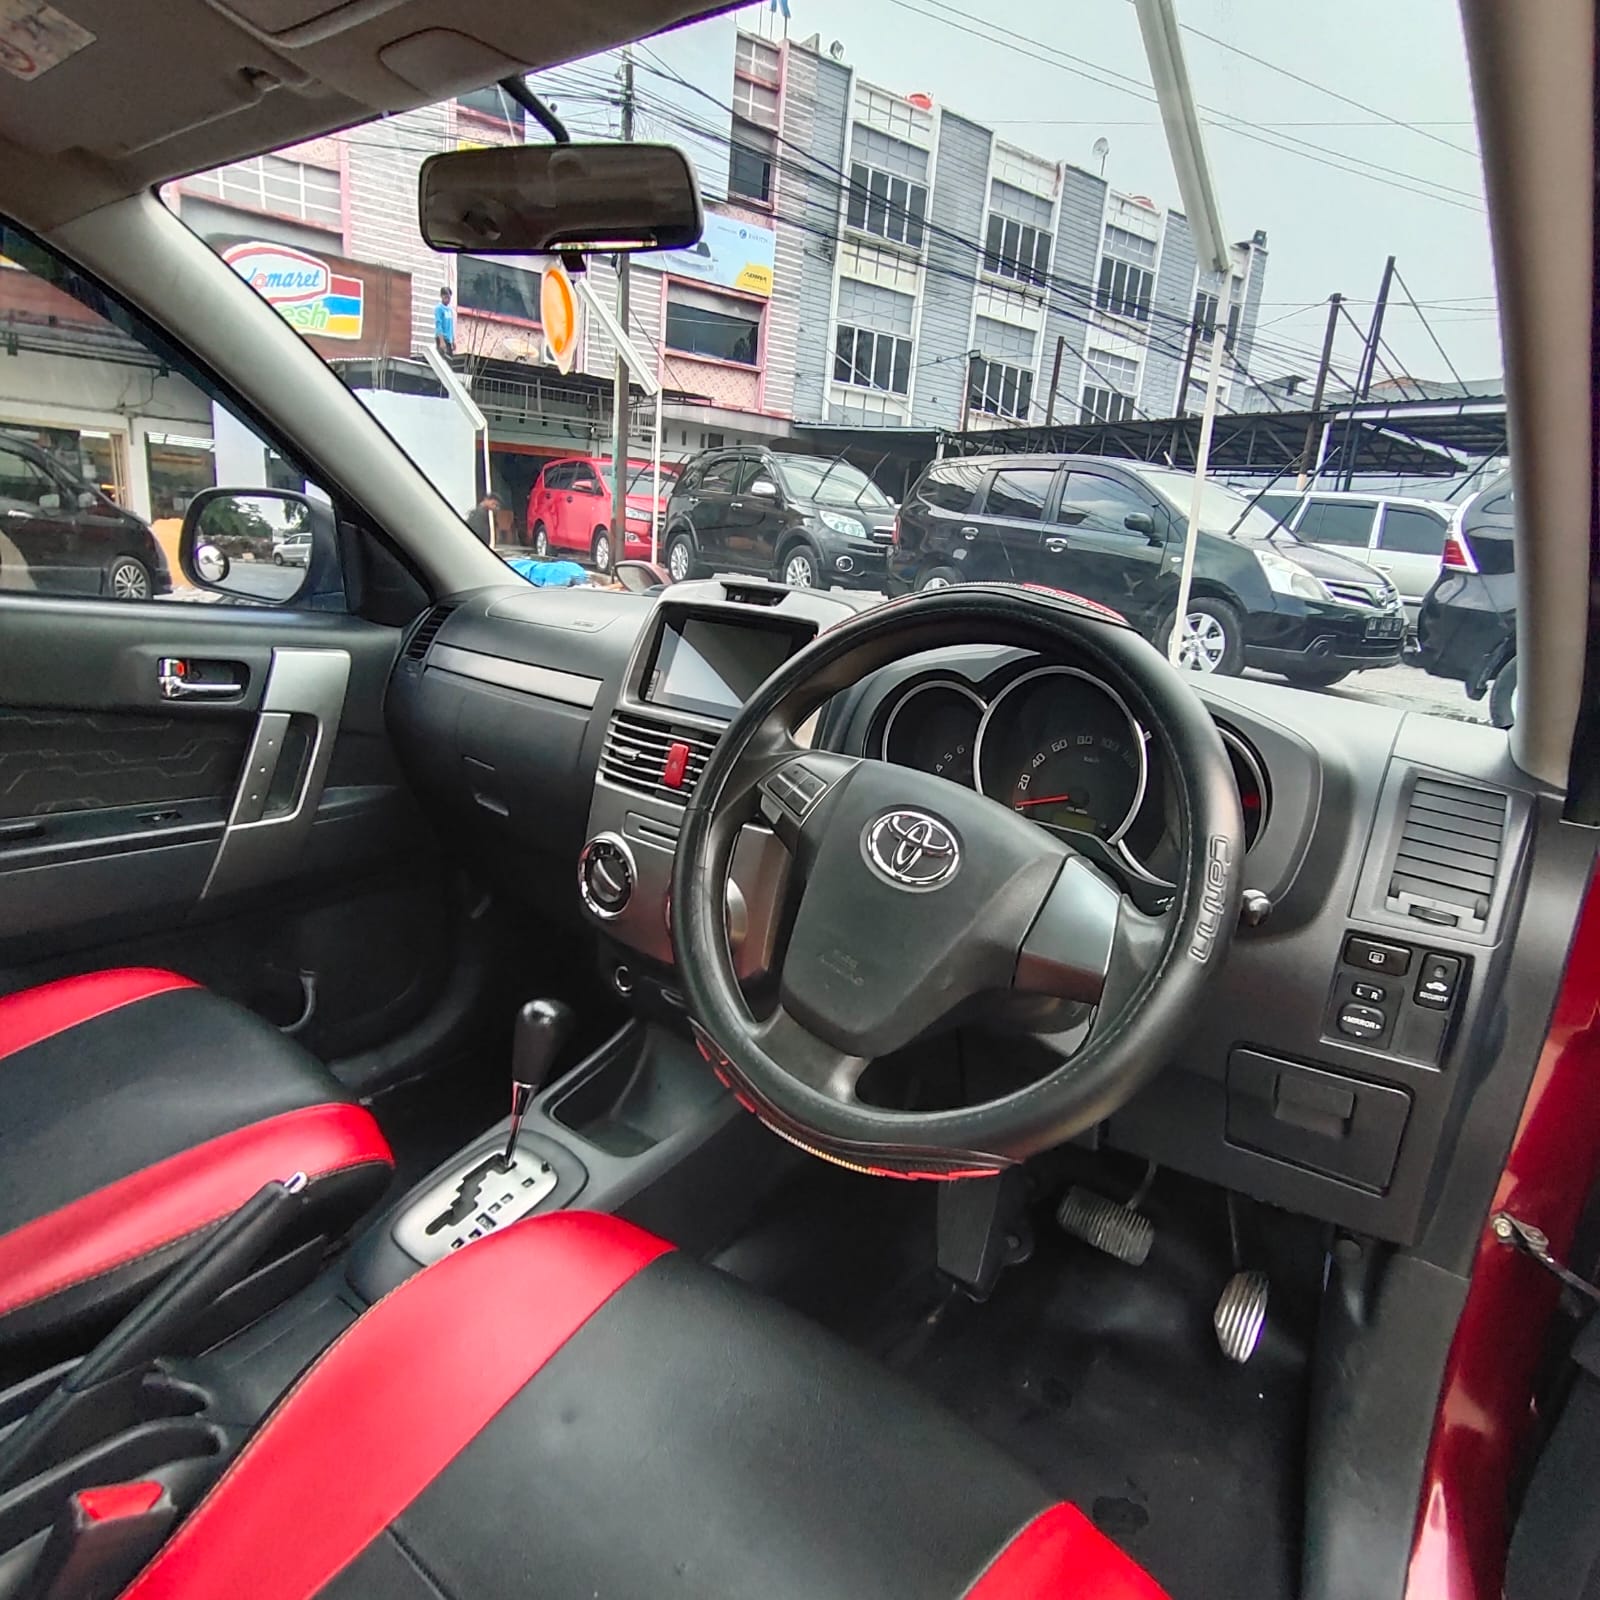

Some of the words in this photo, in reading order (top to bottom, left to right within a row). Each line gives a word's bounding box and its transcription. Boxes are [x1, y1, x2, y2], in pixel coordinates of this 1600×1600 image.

[247, 267, 320, 289] omaret
[956, 744, 965, 754] 6
[1051, 739, 1068, 753] 60
[943, 752, 953, 762] 5
[1032, 752, 1046, 768] 40
[935, 763, 944, 773] 4
[1018, 774, 1031, 790] 20
[1355, 987, 1363, 996] L
[1370, 991, 1379, 1001] R
